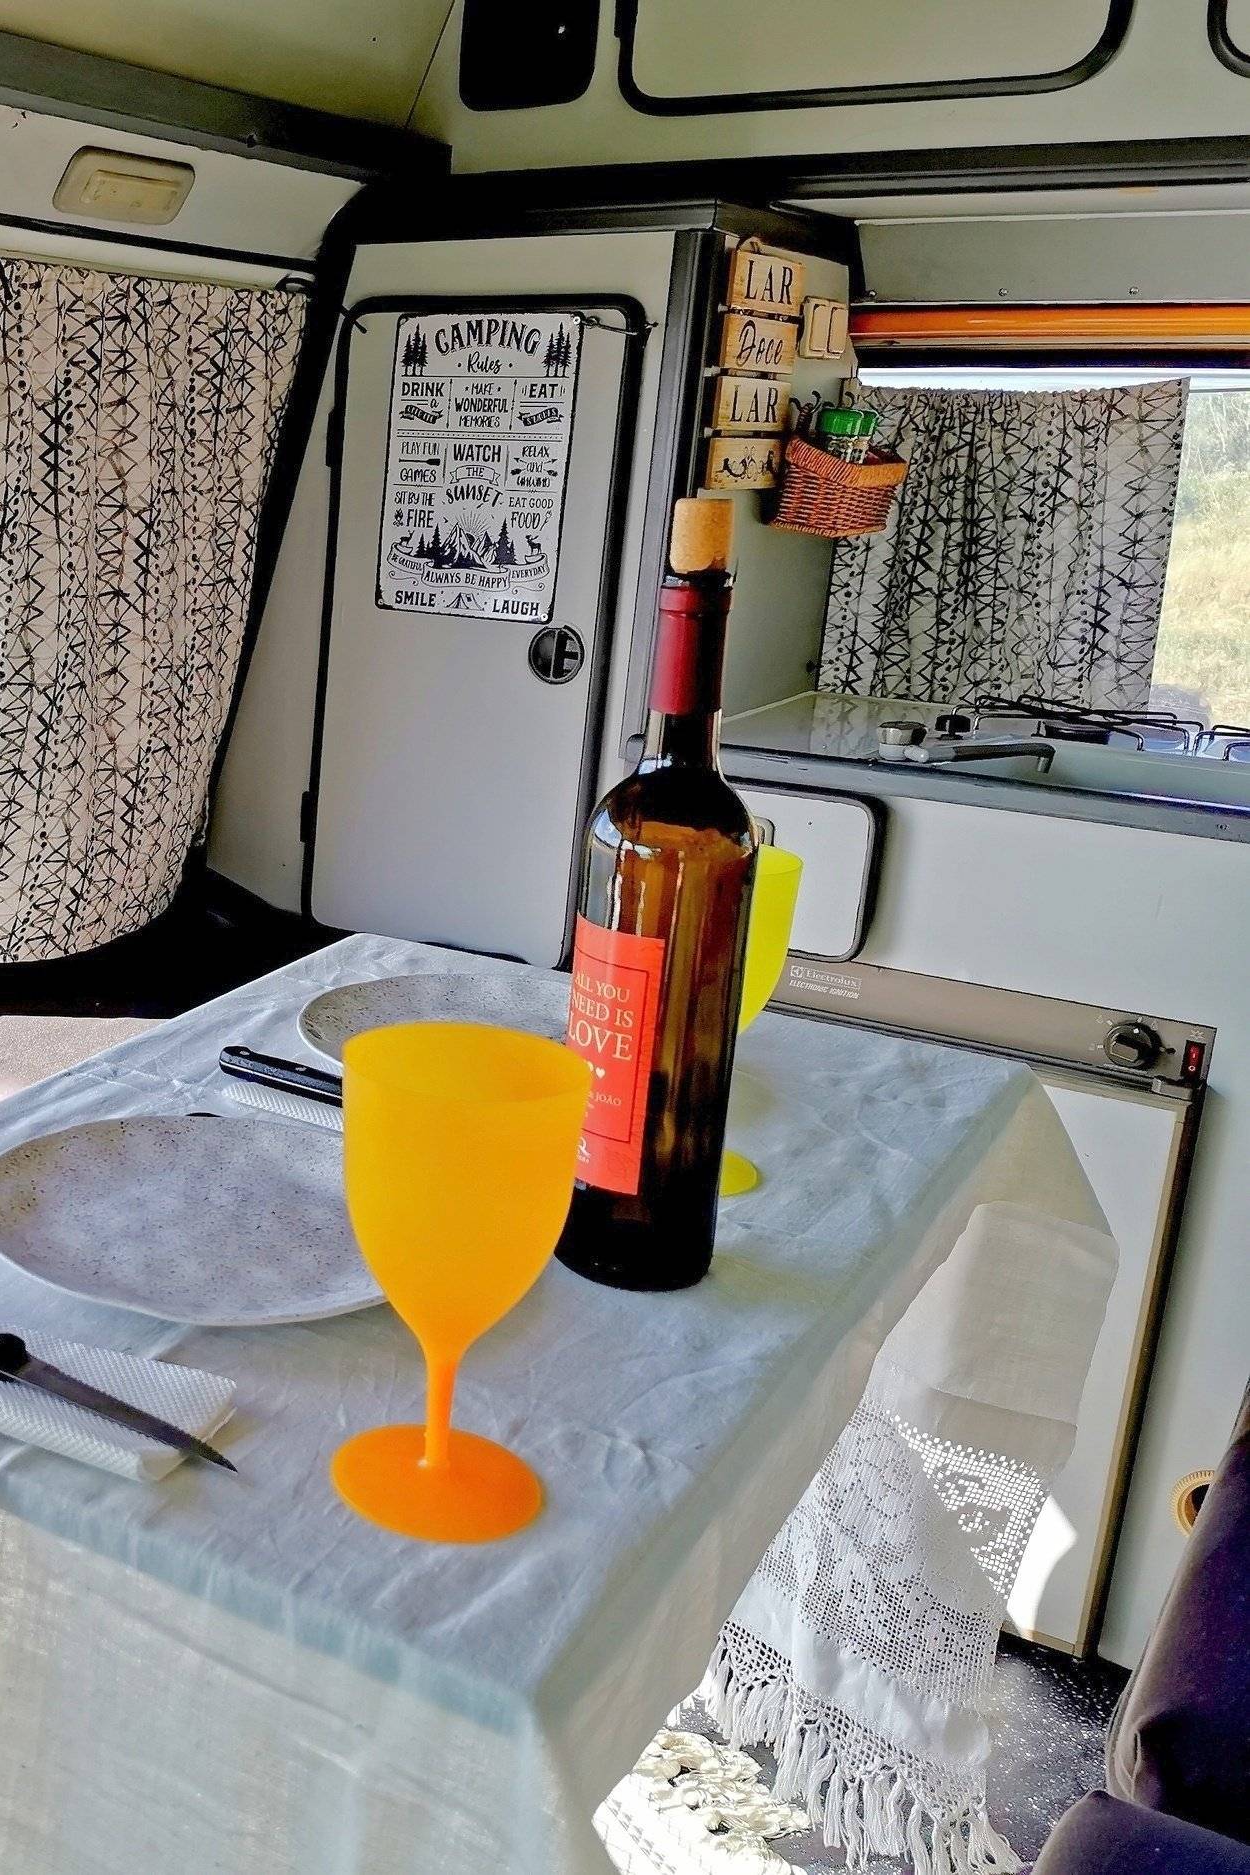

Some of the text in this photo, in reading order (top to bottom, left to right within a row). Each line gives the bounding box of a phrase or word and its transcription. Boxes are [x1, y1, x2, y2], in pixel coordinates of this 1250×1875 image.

[744, 259, 792, 305] LAR
[435, 318, 541, 356] CAMPING
[736, 319, 784, 367] Doce
[467, 351, 502, 374] Rules
[401, 381, 445, 397] DRINK
[471, 383, 494, 395] MAKE
[528, 383, 558, 398] EAT
[455, 397, 508, 413] WONDERFUL
[730, 384, 778, 423] LAR
[459, 415, 500, 428] MEMORIES
[402, 442, 440, 455] PLAY FUN
[453, 444, 501, 462] WATCH
[522, 445, 550, 458] RELAX
[400, 468, 436, 483] GAMES
[466, 467, 484, 478] THE
[394, 491, 435, 507] SIT BY THE
[508, 497, 554, 509] EAT GOOD
[406, 509, 434, 528] FIRE
[511, 512, 541, 530] FOOD
[423, 570, 509, 589] ALWAYS BE HAPPY
[511, 564, 547, 579] EVERYDAY
[395, 590, 437, 607] SMILE
[492, 599, 540, 617] LAUGH
[806, 970, 858, 987] Electrolux
[595, 980, 630, 1003] YOU
[790, 980, 860, 999] ELECTRONIC IGNITION
[572, 988, 634, 1028] NEED IS
[569, 1010, 633, 1061] LOVE
